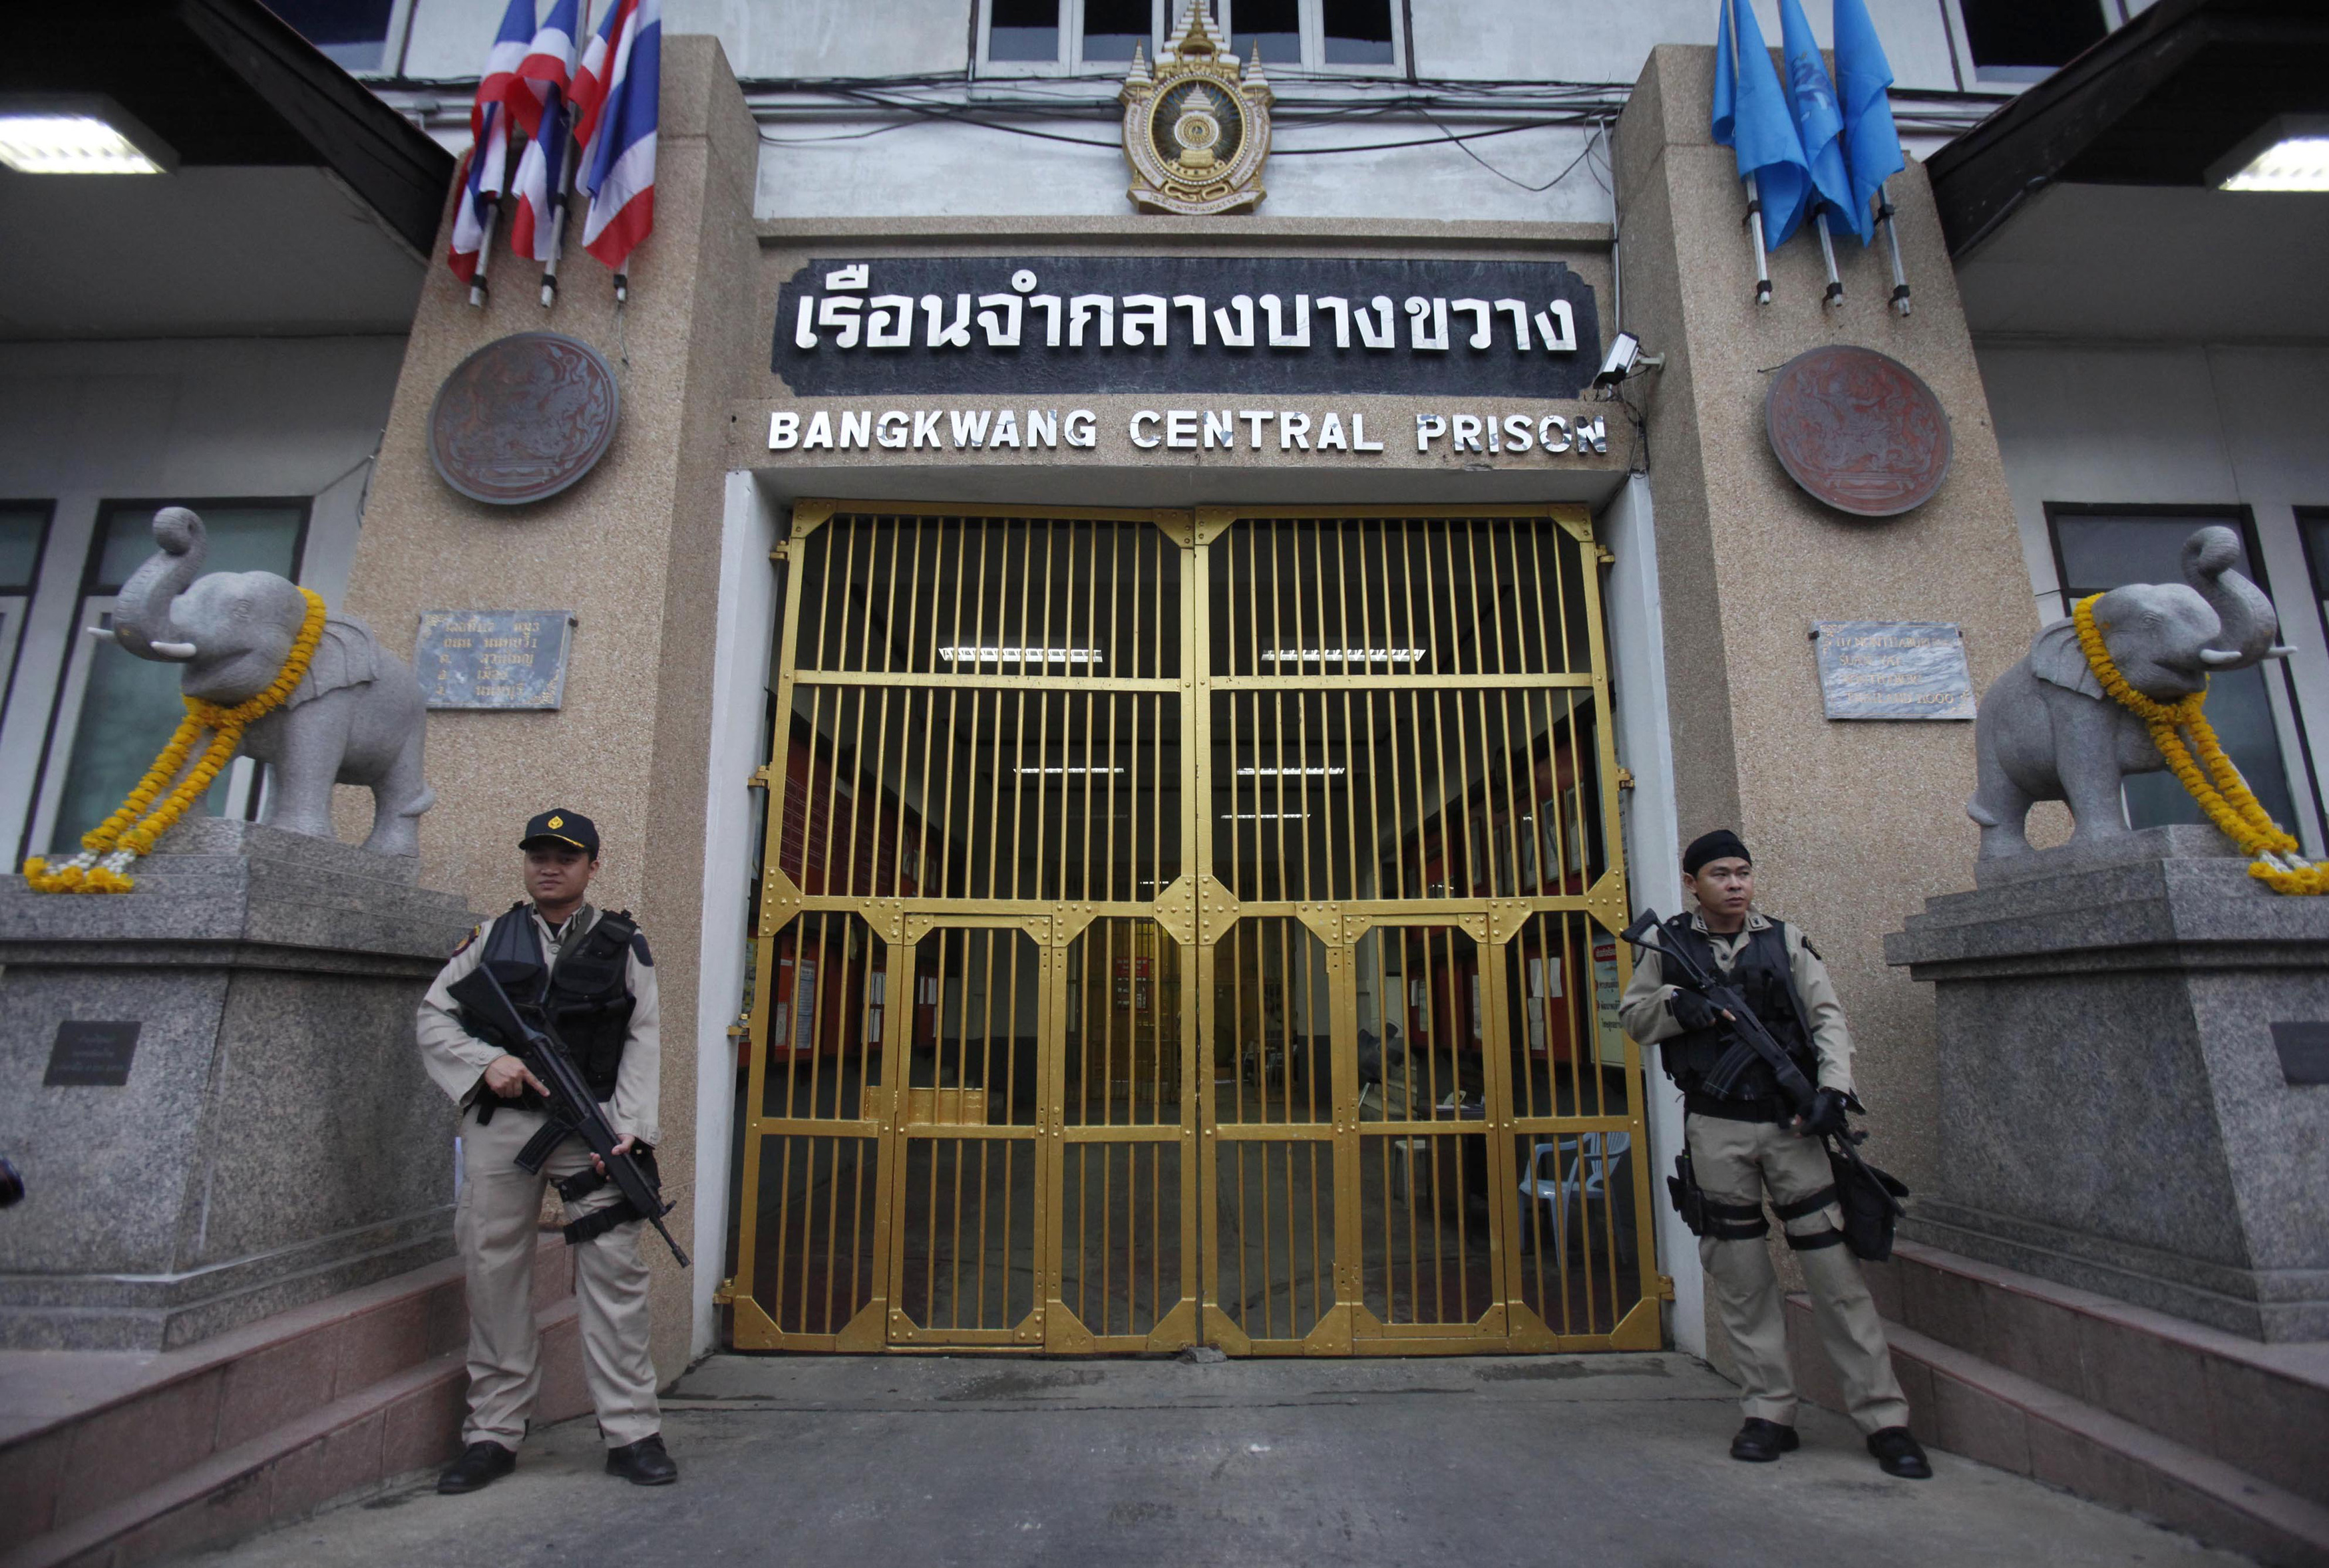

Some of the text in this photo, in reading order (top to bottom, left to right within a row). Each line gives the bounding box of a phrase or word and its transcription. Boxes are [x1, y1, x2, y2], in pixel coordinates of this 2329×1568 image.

[795, 263, 1577, 351] เรือนจำกลางบางขวาง
[768, 409, 1606, 454] BANGKWANG CENTRAL PRISON
